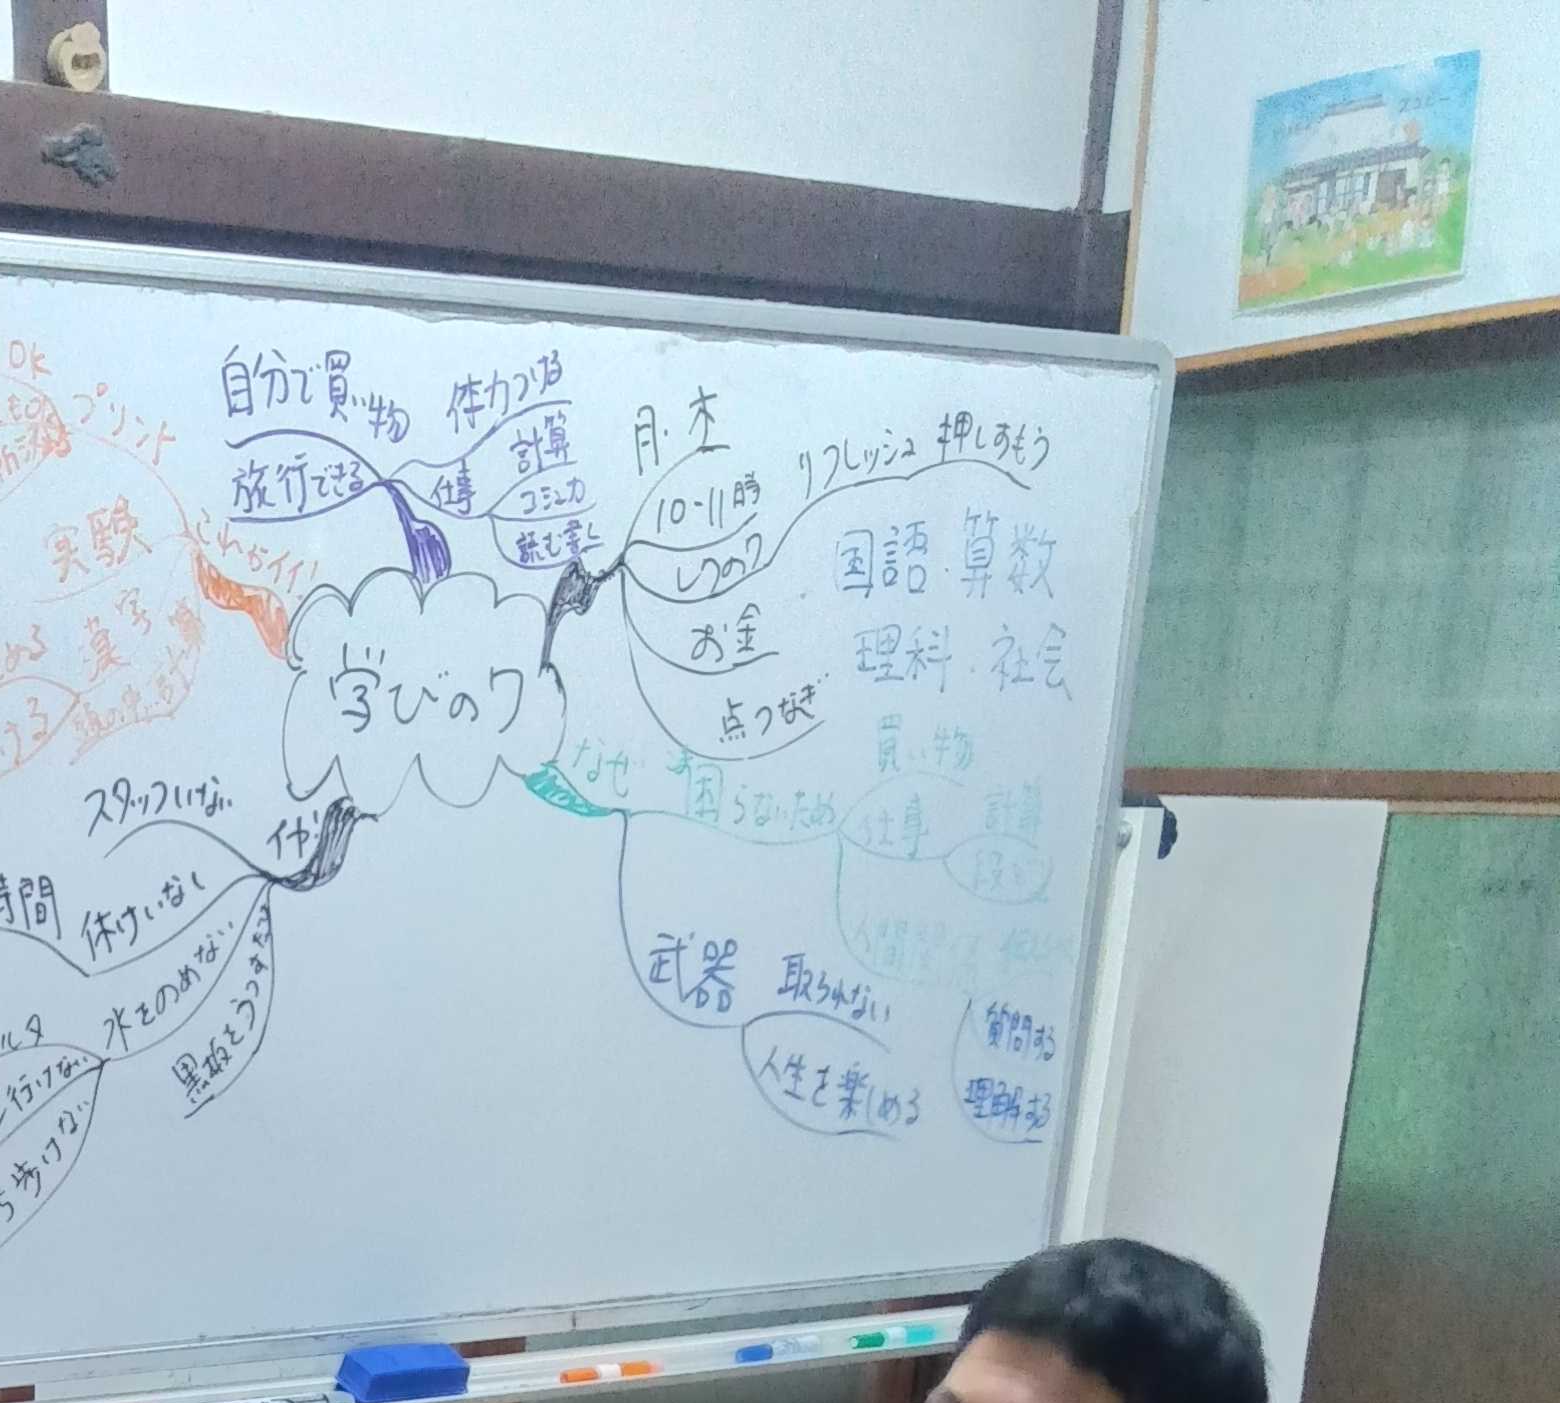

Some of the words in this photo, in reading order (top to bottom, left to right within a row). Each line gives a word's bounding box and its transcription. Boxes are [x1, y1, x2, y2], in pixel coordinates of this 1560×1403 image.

[72, 381, 177, 467] プリント
[221, 344, 411, 442] 自分で買い物
[510, 410, 578, 474] 計算
[799, 428, 916, 499] リフレッシュ
[232, 453, 365, 514] 旅行できる
[430, 458, 478, 515] 仕事
[43, 494, 153, 584] 実験
[690, 602, 763, 663] お金
[649, 931, 738, 1013] 武器
